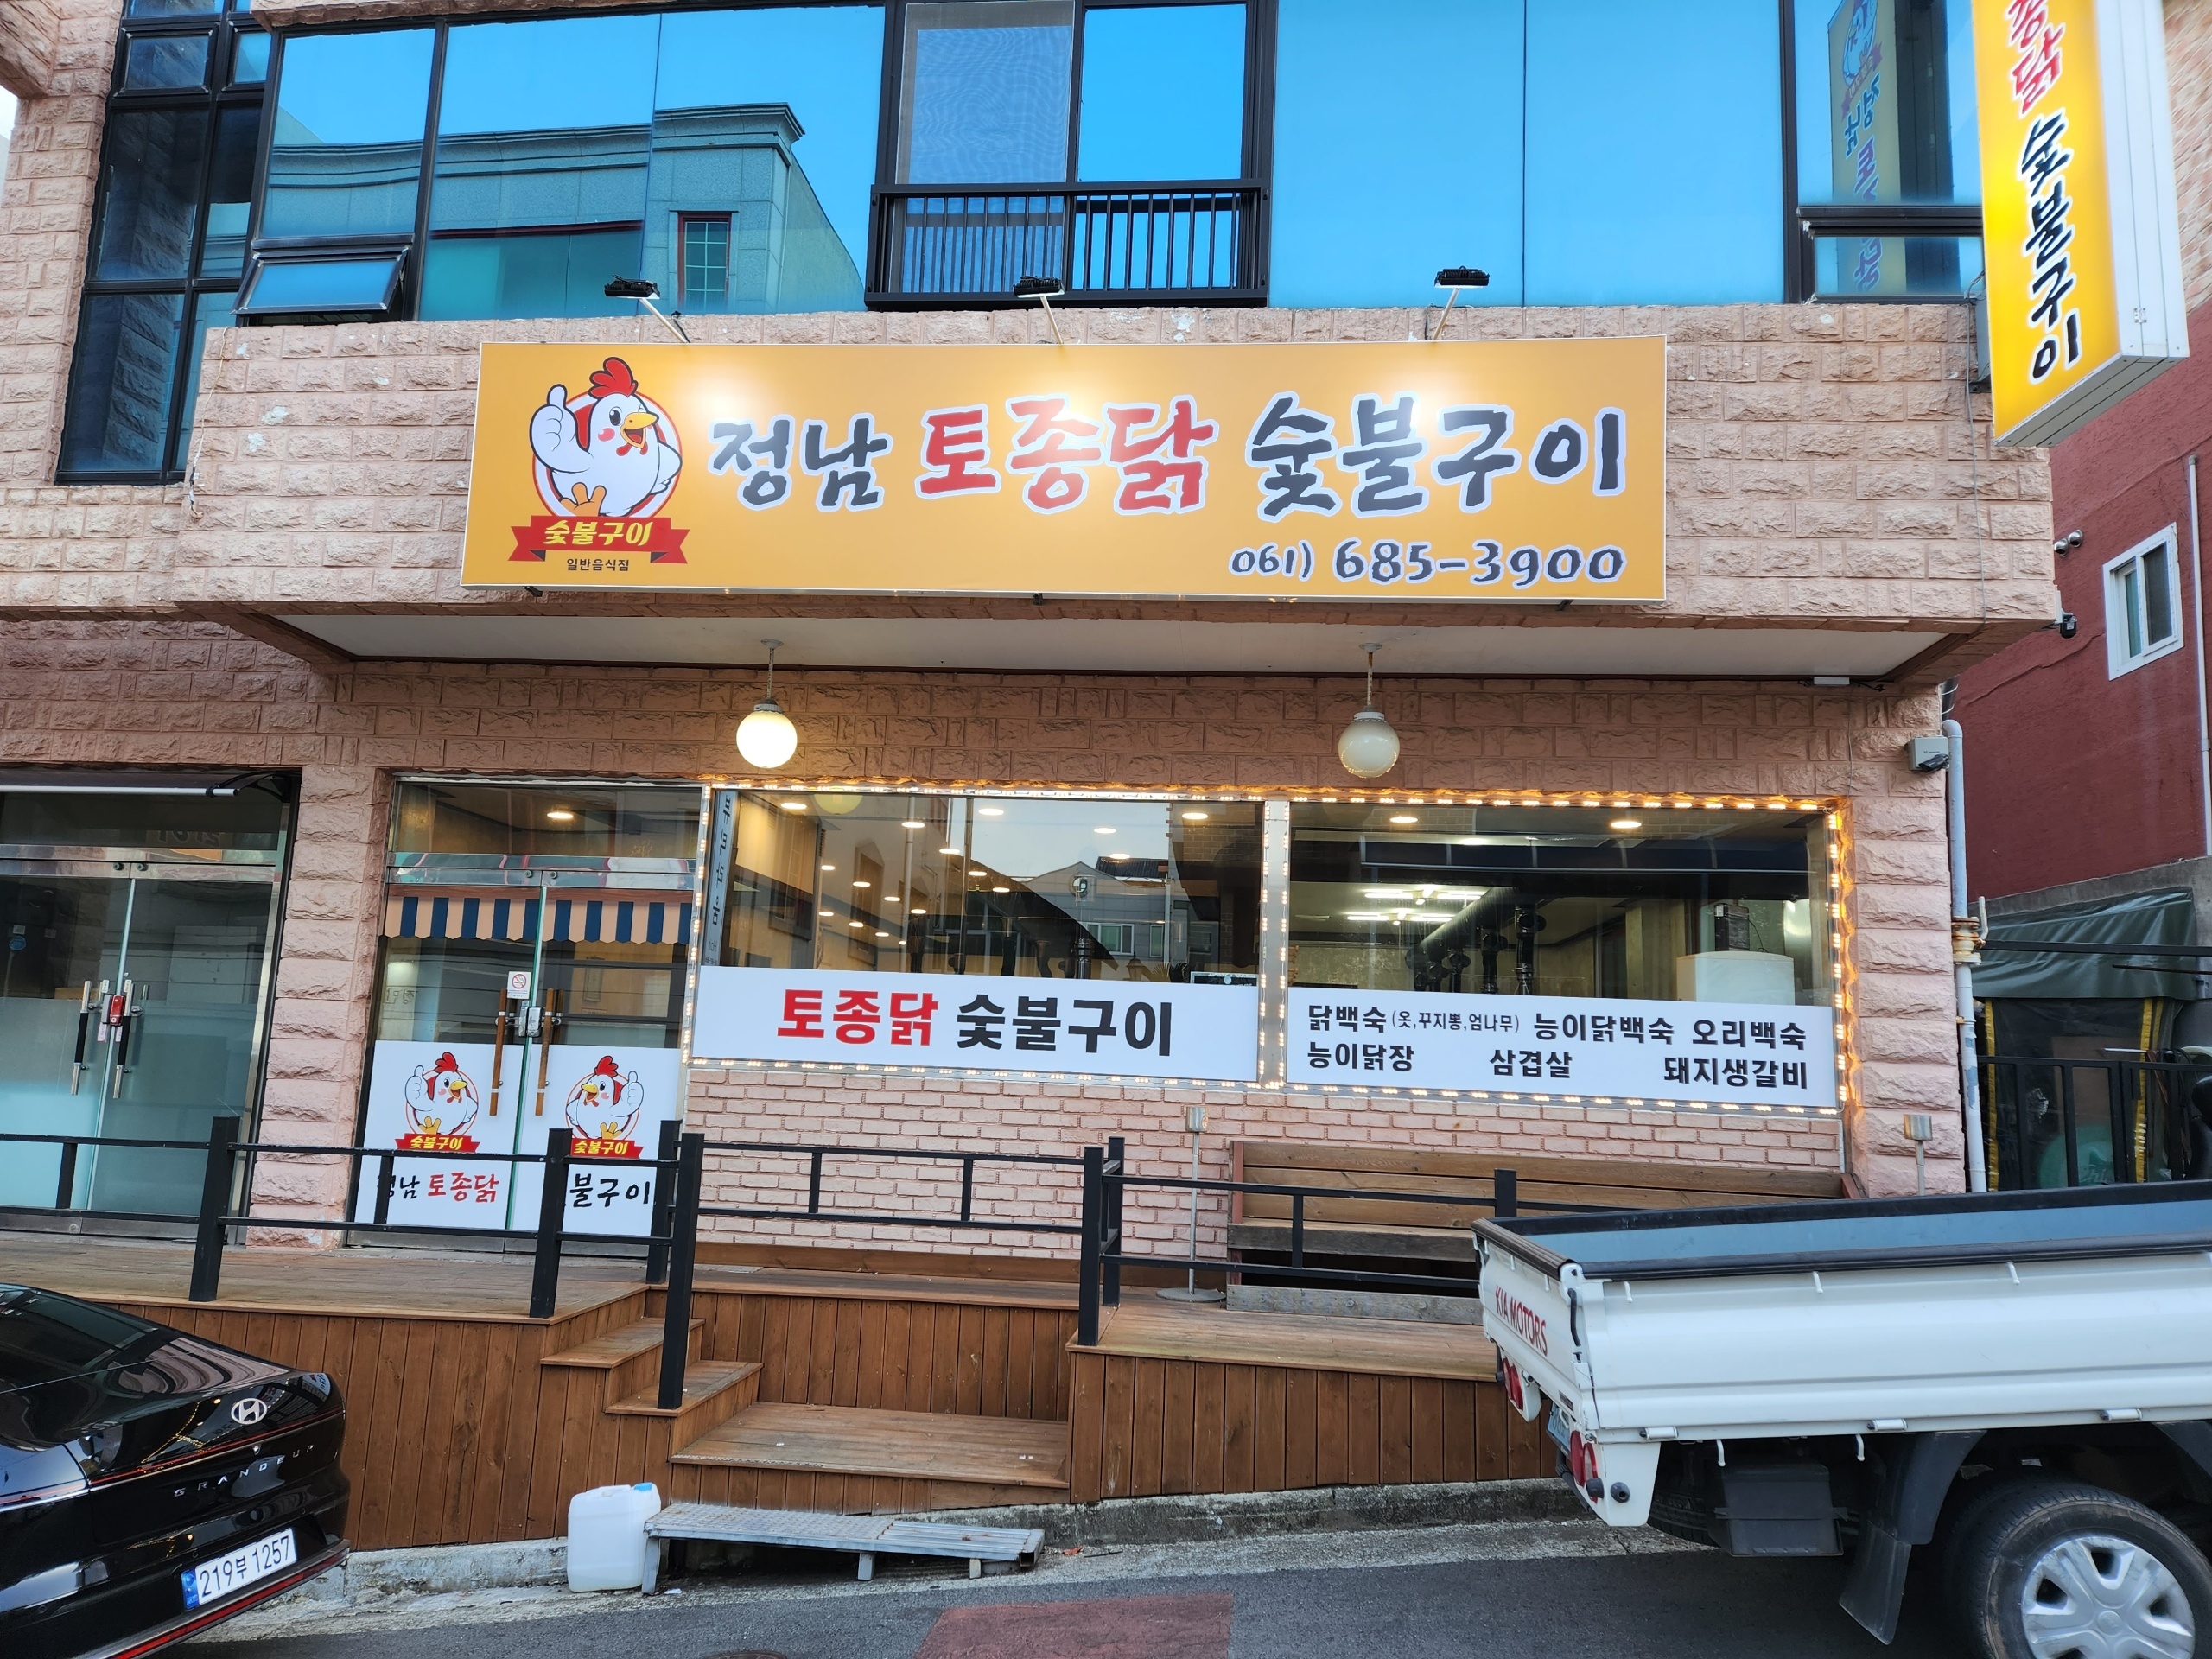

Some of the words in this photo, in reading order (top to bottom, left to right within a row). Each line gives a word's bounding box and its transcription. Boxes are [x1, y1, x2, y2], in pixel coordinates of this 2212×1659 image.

[2021, 112, 2080, 380] 숯불구이
[710, 415, 890, 511] 정남
[918, 397, 1217, 515] 토종닭
[1249, 394, 1622, 519] 숯불구이
[543, 519, 654, 546] 숯불구이
[567, 558, 629, 571] 일반음식점
[1230, 542, 1313, 581] 061)
[1333, 539, 1625, 588] 685-3900
[777, 988, 939, 1047] 토종닭
[956, 994, 1173, 1057] 숯불구이
[1308, 1005, 1387, 1033] 닭백숙
[1534, 1013, 1675, 1045] 능이닭백숙
[1692, 1020, 1807, 1050] 오리백숙
[1307, 1041, 1414, 1072] 능이닭장
[1490, 1049, 1573, 1078] 삼겹살
[1664, 1057, 1808, 1090] 돼지생갈비
[410, 1135, 463, 1151] 숯불구이
[573, 1140, 628, 1154] 숯불구이
[428, 1172, 500, 1203] 토종닭
[565, 1173, 650, 1207] 불구이
[1495, 1285, 1510, 1322] KIA
[1510, 1296, 1548, 1357] MOTORS
[174, 1444, 314, 1497] GRANDEUR
[200, 1555, 247, 1598] 219부
[252, 1535, 289, 1573] 1257
